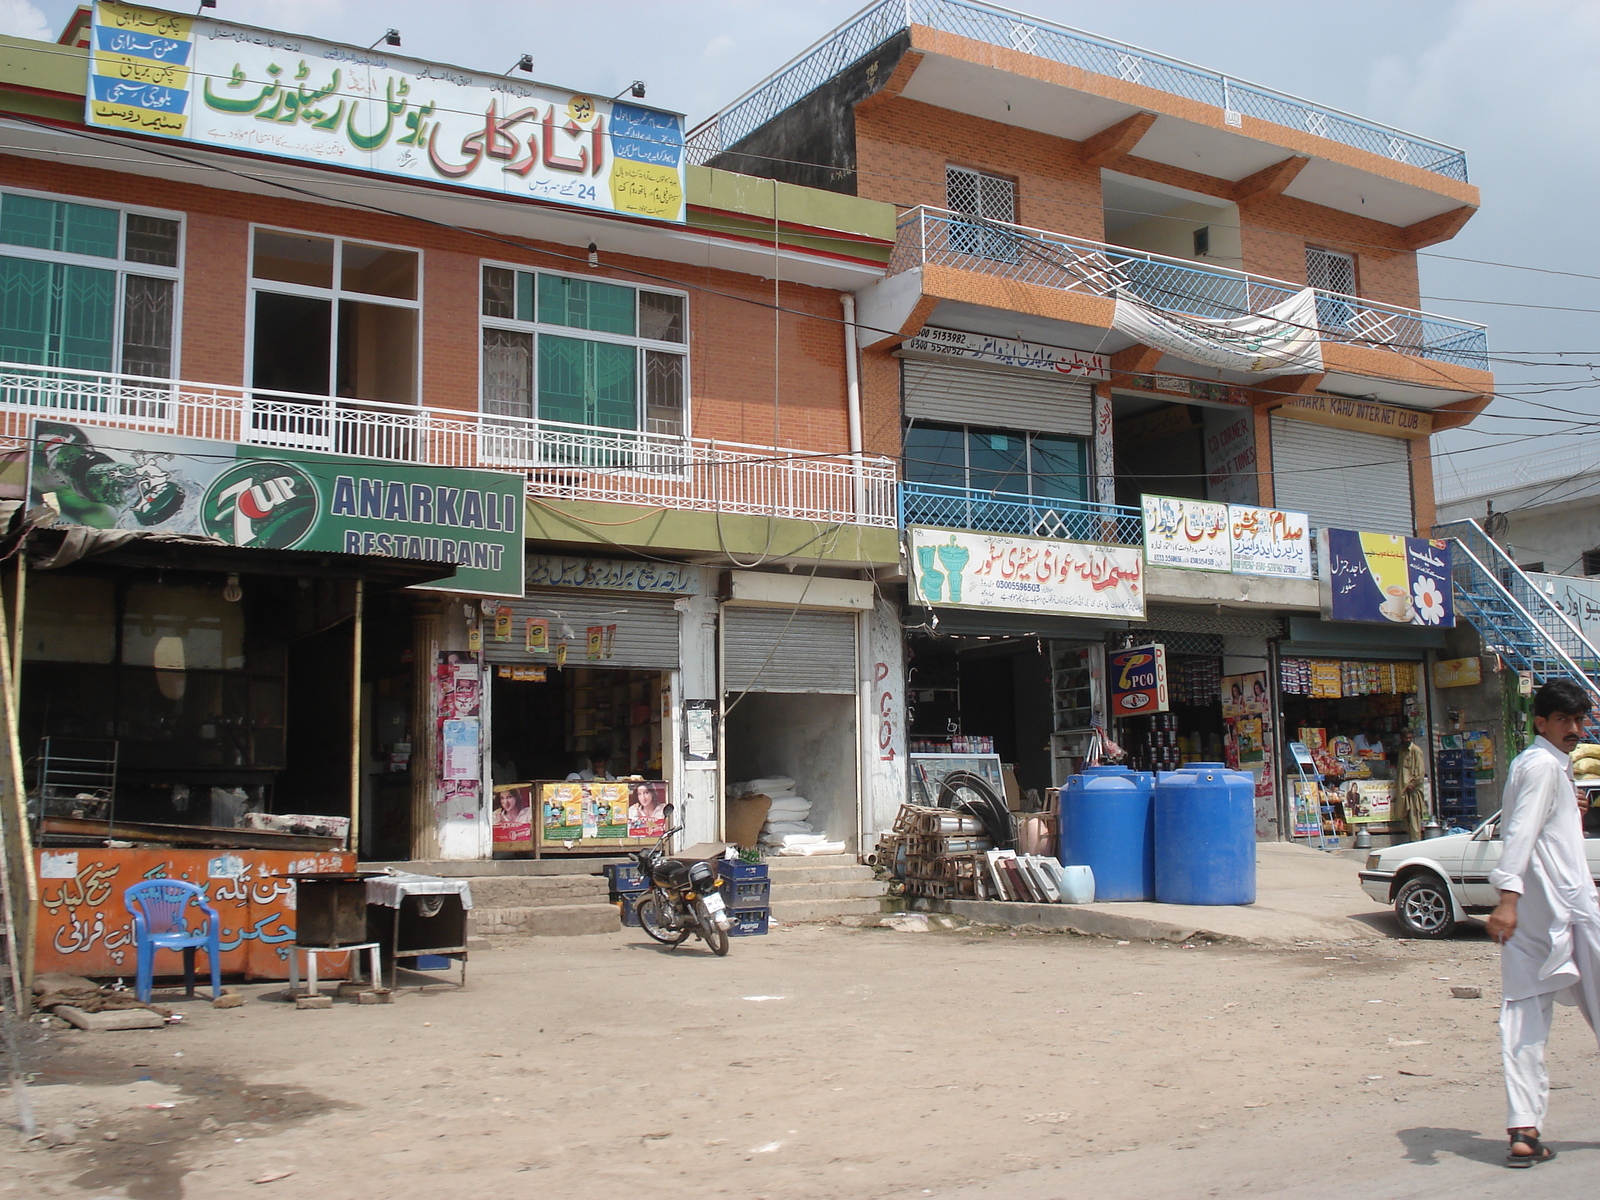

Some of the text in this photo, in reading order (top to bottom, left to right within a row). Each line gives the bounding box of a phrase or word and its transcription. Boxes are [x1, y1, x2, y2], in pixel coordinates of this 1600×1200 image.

[158, 19, 180, 35] چکن
[154, 41, 178, 58] مٹن
[203, 59, 345, 132] ریسٹورنٹ
[346, 75, 434, 151] ہوٹل
[428, 98, 603, 178] انارکلی
[578, 184, 596, 201] 24
[910, 339, 928, 351] 0300
[933, 330, 966, 345] 5133982
[1330, 398, 1355, 417] KAHU
[1398, 411, 1419, 429] CLUB
[1208, 435, 1219, 454] CD
[1219, 418, 1250, 447] CORNER
[1233, 446, 1256, 472] TONES
[331, 475, 517, 534] ANARKALI
[343, 530, 505, 572] RESTAURANT
[1409, 545, 1445, 567] حلیب
[660, 568, 691, 593] راجہ
[1091, 557, 1140, 597] بسم
[1350, 560, 1367, 577] ساجد
[996, 579, 1041, 593] 03005596503
[1132, 673, 1154, 688] PCO
[1156, 649, 1166, 703] PCO
[42, 862, 95, 915] کباب
[740, 922, 760, 931] PEPSI
